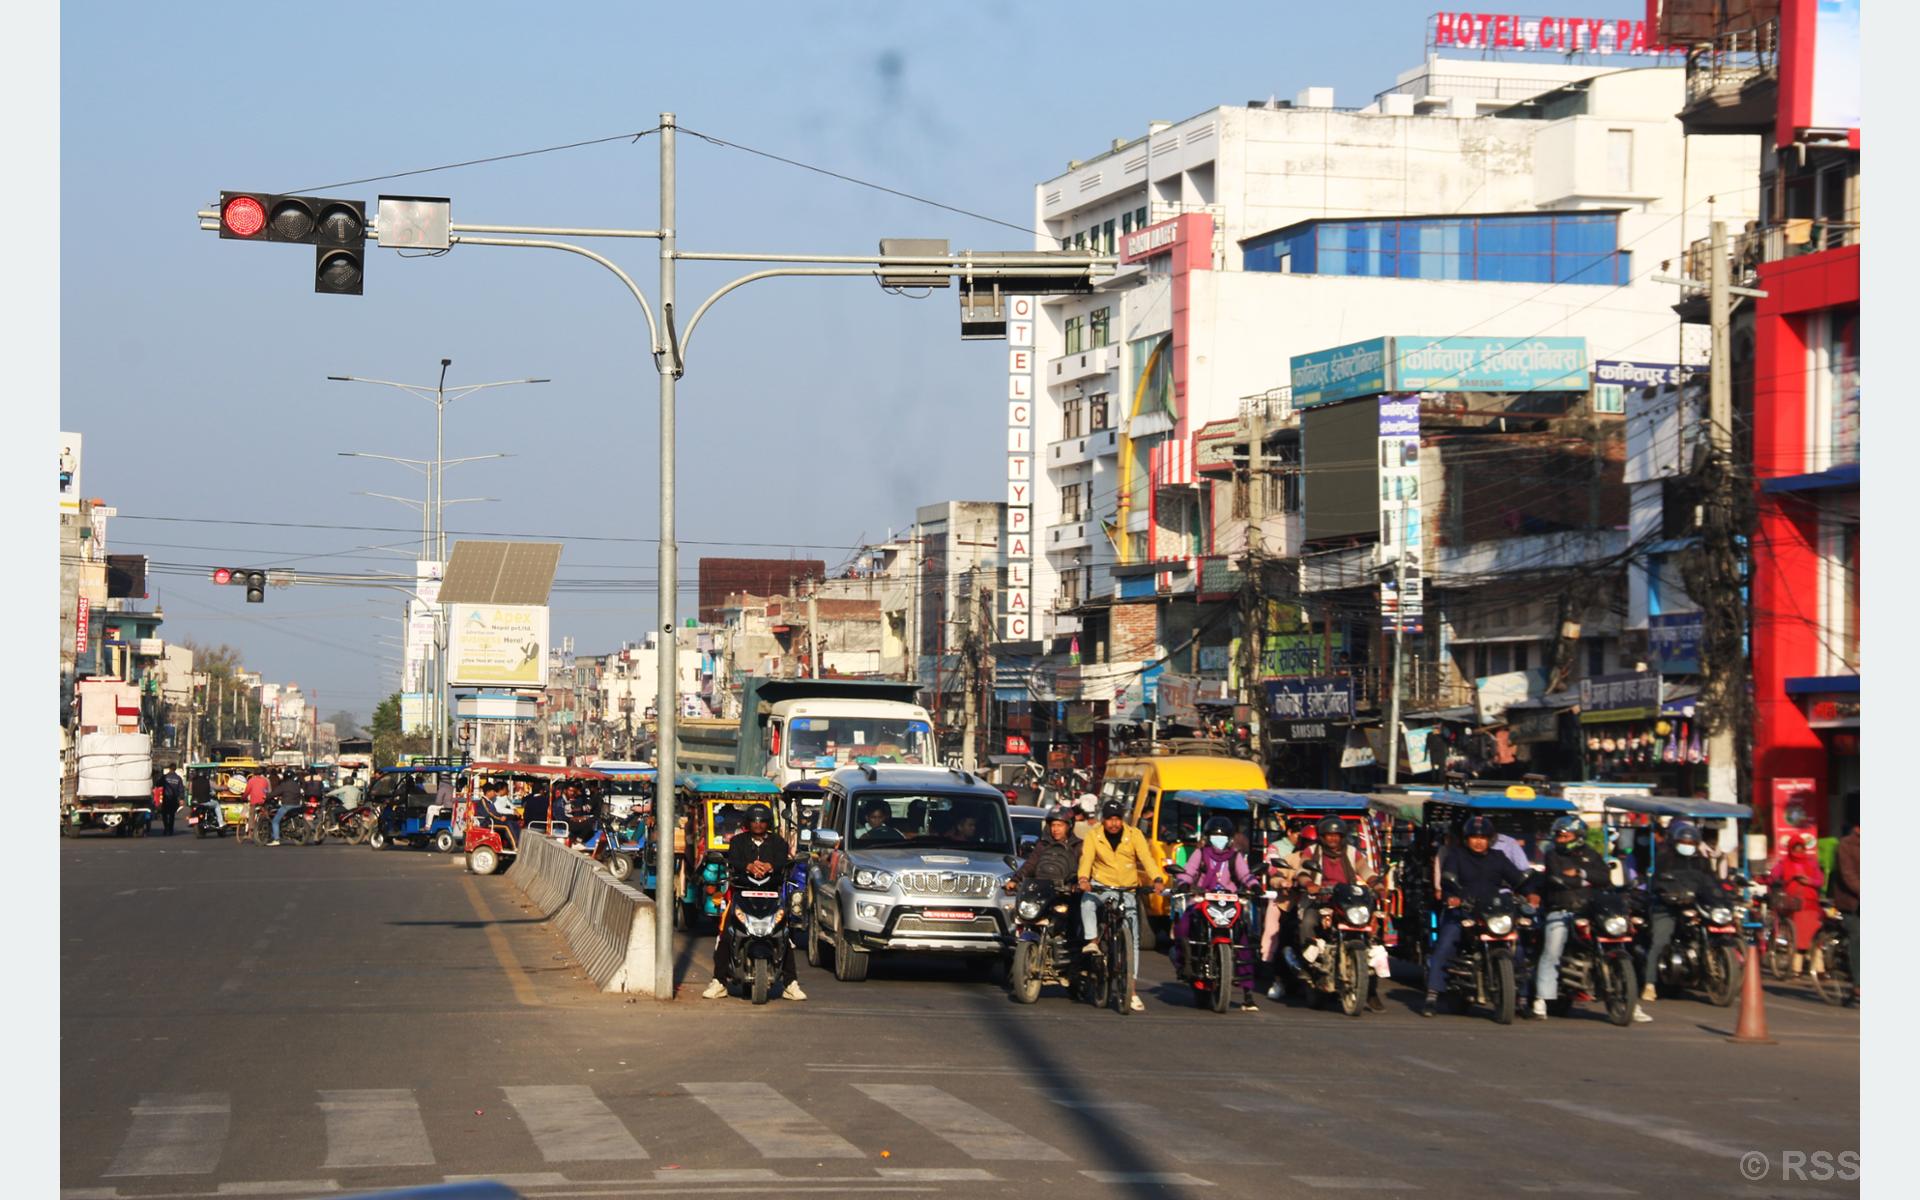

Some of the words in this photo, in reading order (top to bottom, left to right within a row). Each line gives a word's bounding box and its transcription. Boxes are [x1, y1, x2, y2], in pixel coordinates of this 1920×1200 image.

[1436, 12, 1525, 47] HOTEL
[1538, 16, 1605, 50] CITY
[1458, 379, 1504, 388] SAMSUNG
[1597, 361, 1668, 387] कान्तिपुर
[1291, 723, 1326, 738] SAMSUNG
